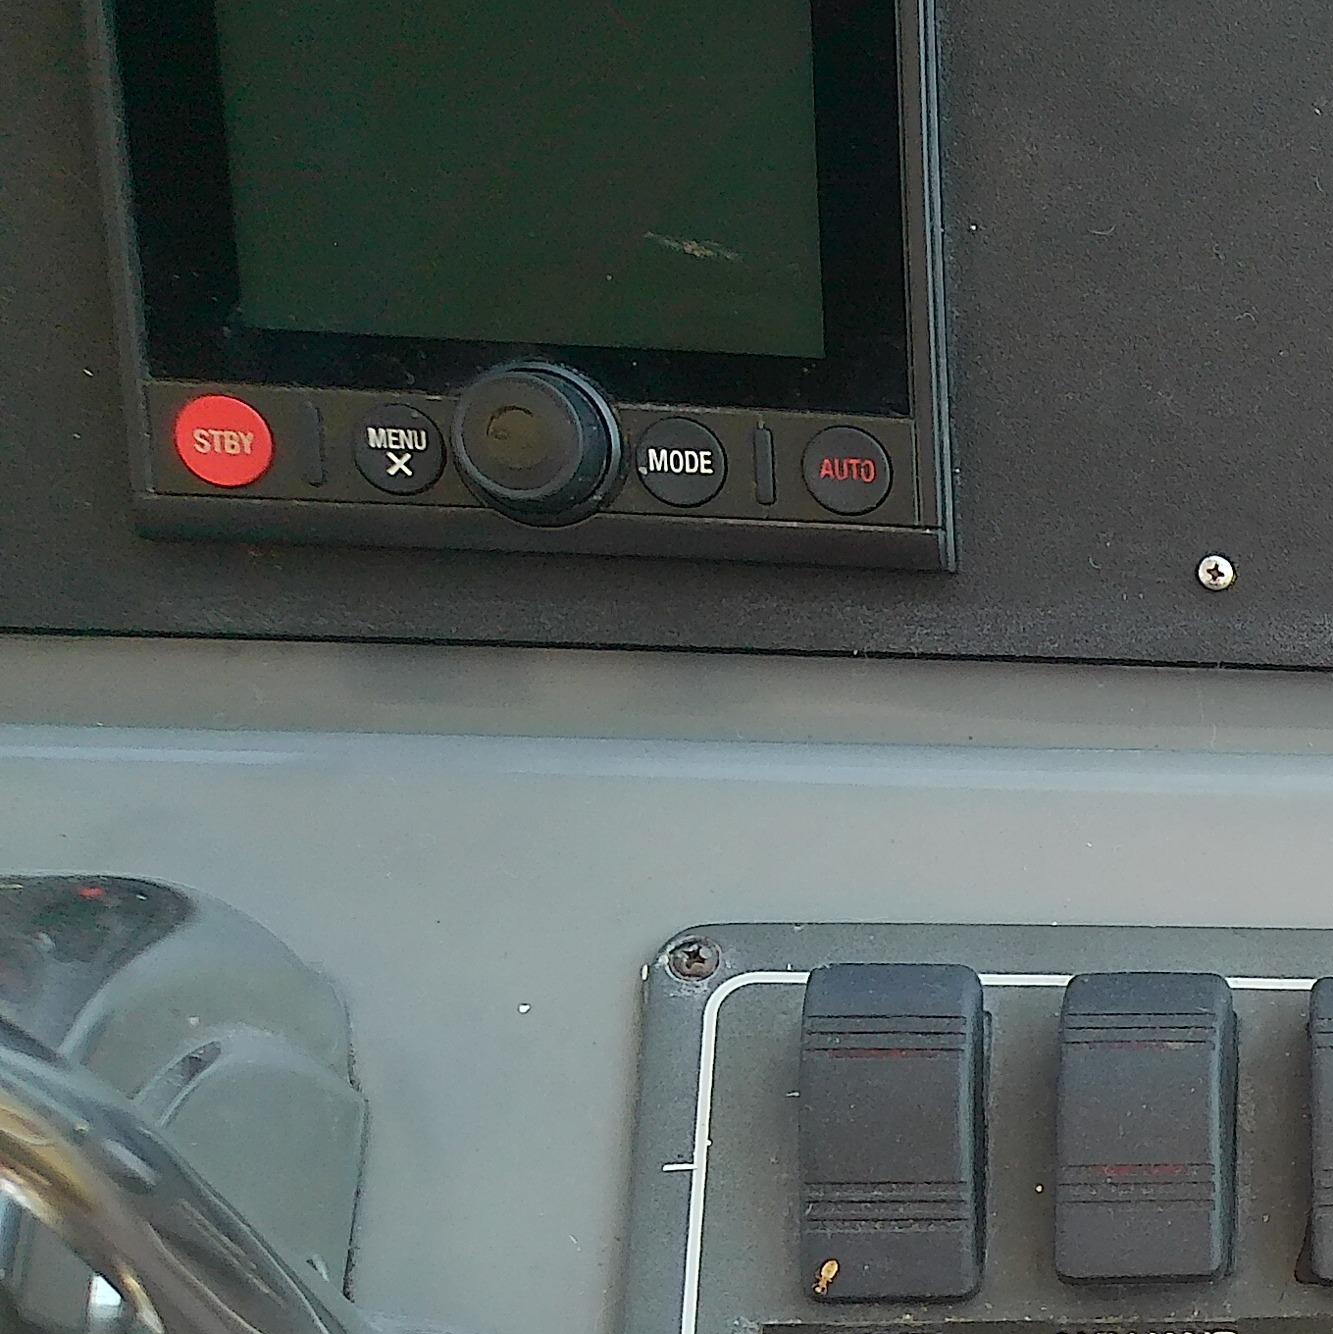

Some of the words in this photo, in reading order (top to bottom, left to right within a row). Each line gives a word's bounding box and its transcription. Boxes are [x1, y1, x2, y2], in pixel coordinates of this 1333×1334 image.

[192, 428, 253, 455] STBY
[368, 428, 427, 451] MENU
[648, 449, 714, 475] MODE
[819, 457, 876, 482] AUTO
